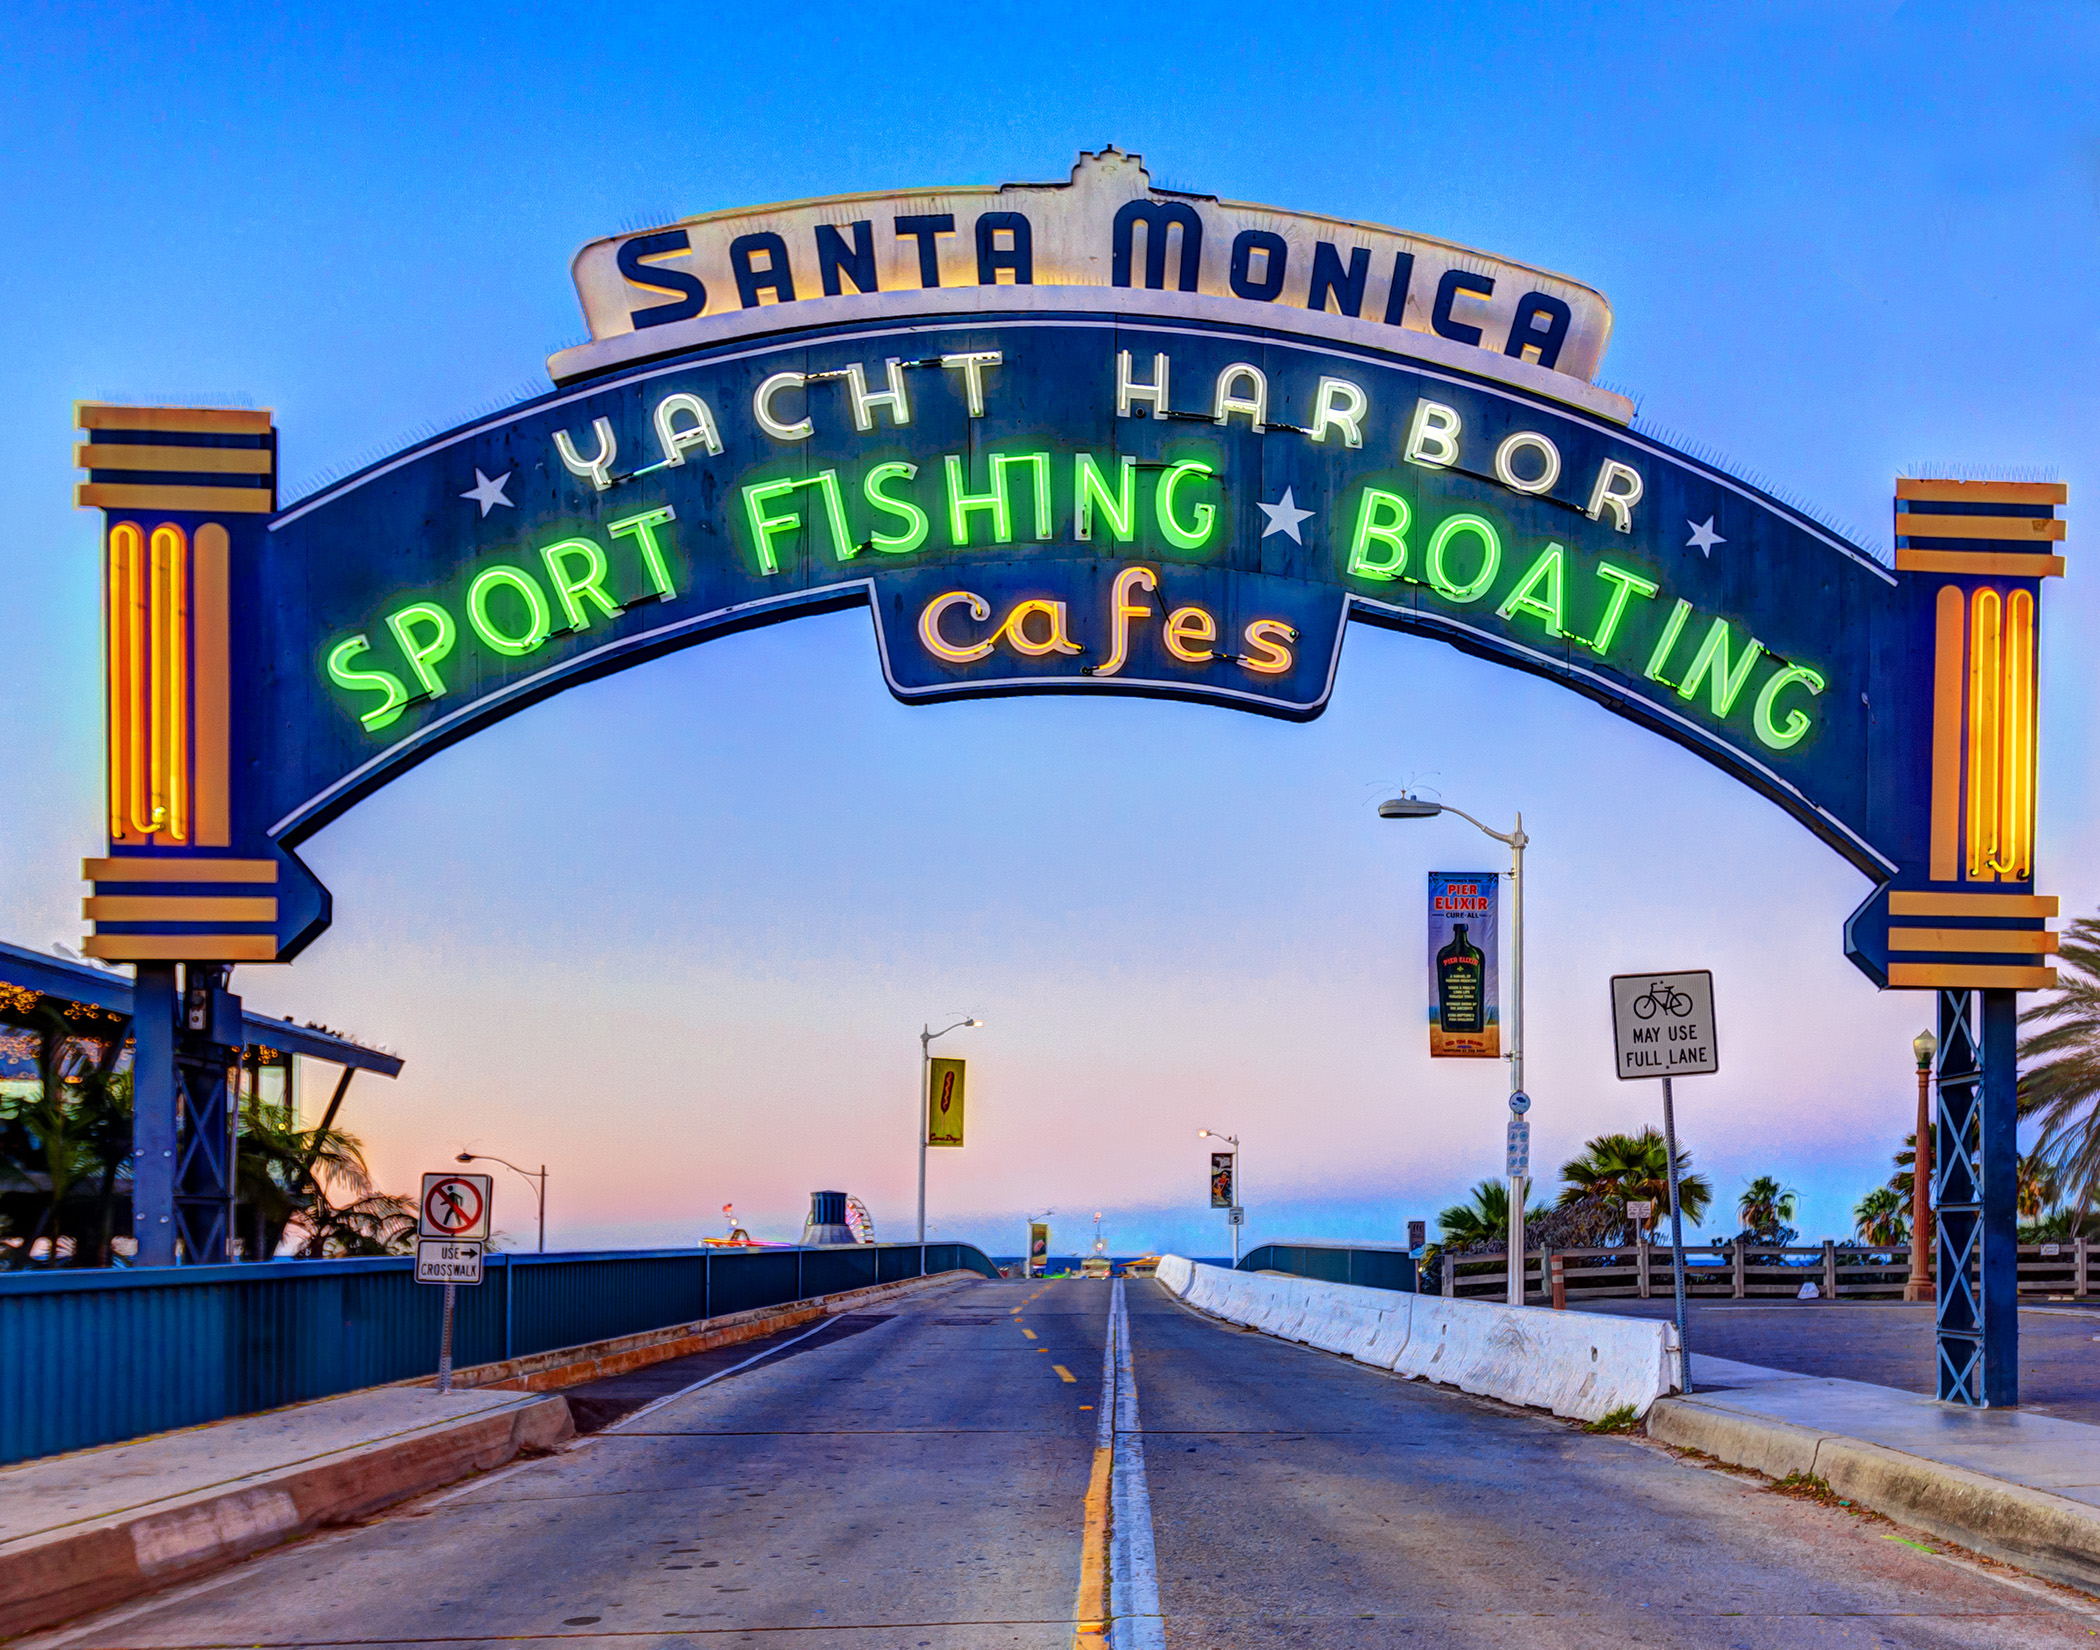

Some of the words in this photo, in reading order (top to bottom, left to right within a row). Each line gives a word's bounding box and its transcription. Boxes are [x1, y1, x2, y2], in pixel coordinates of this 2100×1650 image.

[616, 211, 1033, 331] SANTA
[1112, 199, 1572, 370] MONICA
[551, 350, 1003, 491] YACHT
[1116, 350, 1644, 534] HARBOR
[327, 504, 677, 733] SPORT
[741, 452, 1216, 576] FISHING
[1347, 486, 1825, 750] BOATING
[1447, 884, 1478, 895] PIER
[1435, 896, 1488, 910] ELIXIR
[1443, 956, 1458, 966] PIER
[1633, 1027, 1661, 1044] MAY
[1668, 1024, 1698, 1041] USE
[1626, 1050, 1663, 1067] FULL
[1669, 1047, 1708, 1065] LANE
[441, 1247, 459, 1260] USE
[421, 1263, 477, 1277] CROSSWALK
